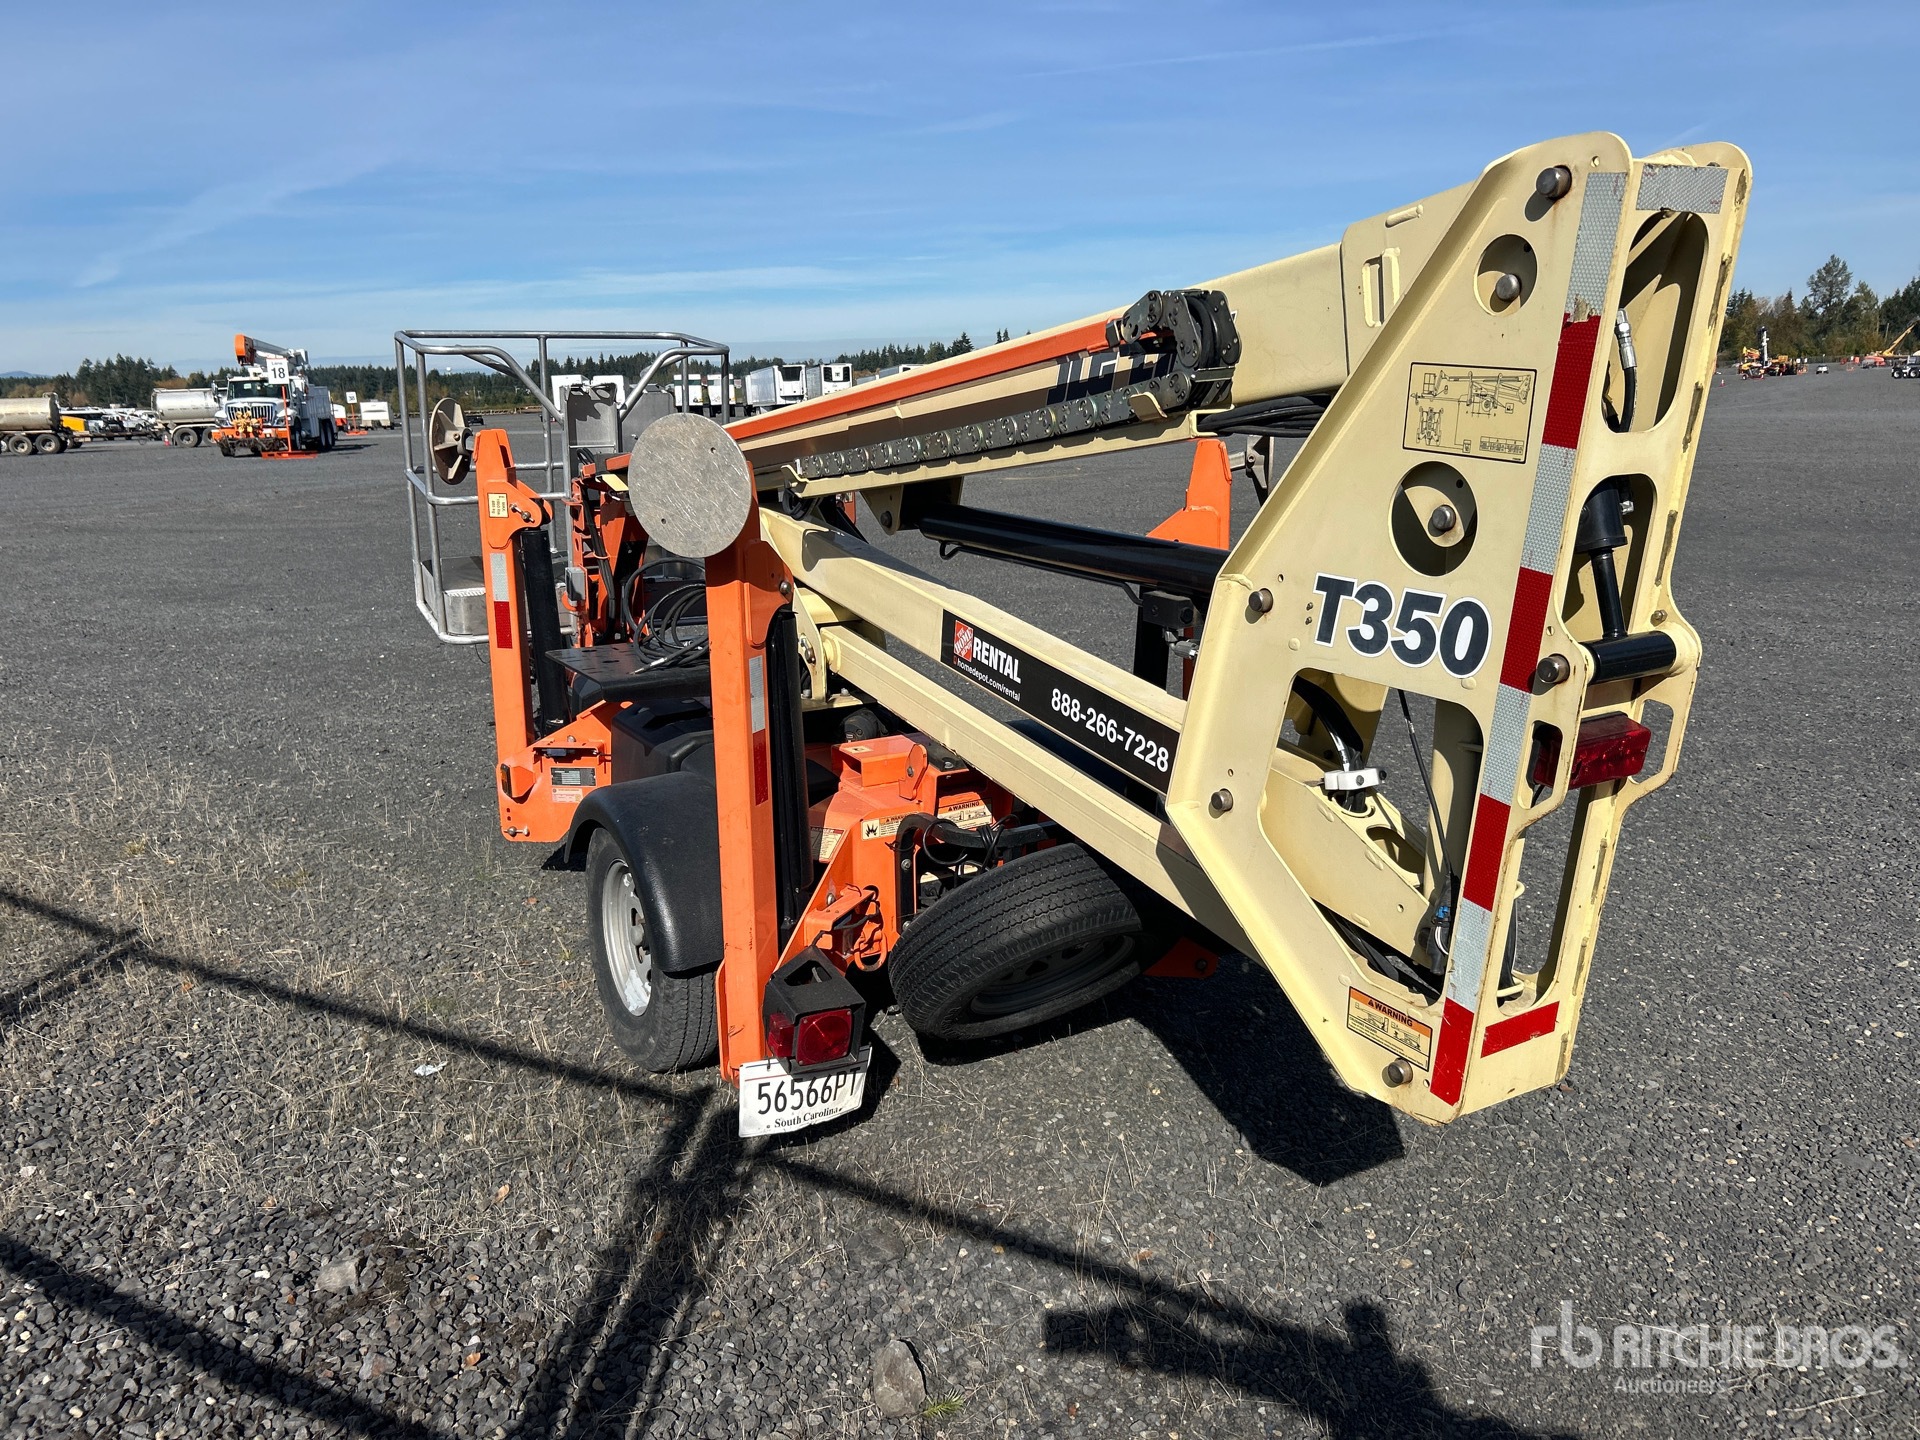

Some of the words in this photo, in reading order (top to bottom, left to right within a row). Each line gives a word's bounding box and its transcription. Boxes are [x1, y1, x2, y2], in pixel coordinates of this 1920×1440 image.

[271, 367, 286, 379] 18
[1313, 572, 1492, 678] T350
[957, 658, 1021, 702] homedepot.com/rental
[972, 636, 1022, 684] RENTAL
[1051, 688, 1169, 773] 888-266-7228
[953, 801, 980, 811] WARNING
[1373, 1000, 1413, 1027] WARNING
[757, 1066, 861, 1115] 56566PT
[774, 1117, 802, 1128] South
[803, 1107, 838, 1122] Carolina
